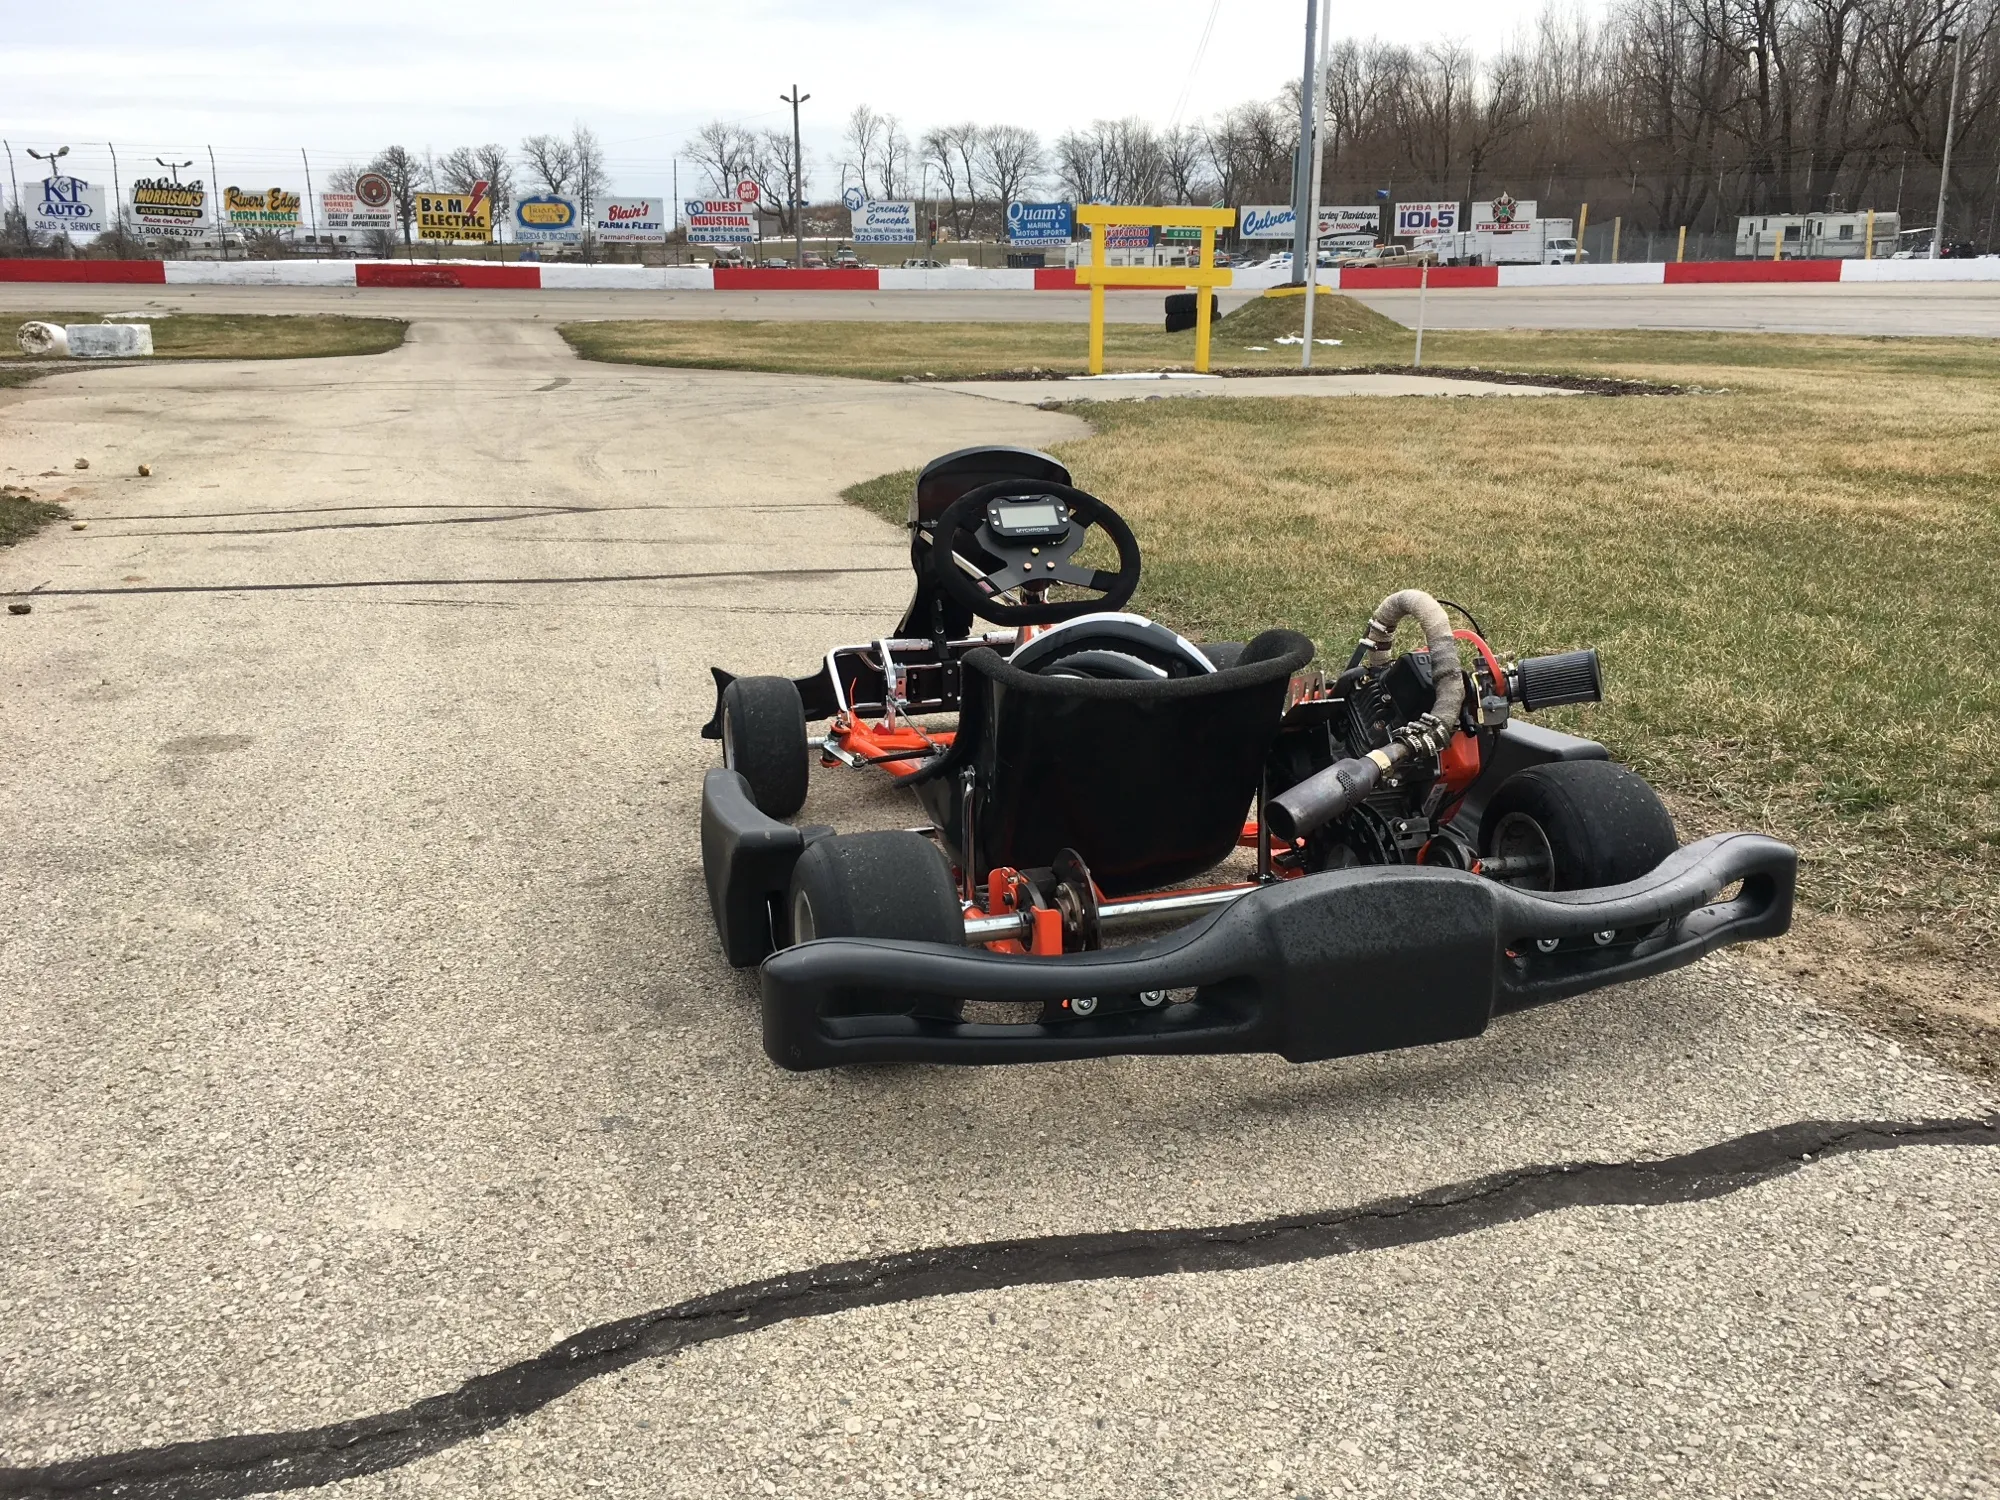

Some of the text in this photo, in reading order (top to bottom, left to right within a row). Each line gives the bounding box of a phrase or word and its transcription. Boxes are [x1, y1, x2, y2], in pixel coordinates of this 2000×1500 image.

[134, 187, 203, 206] MORRISON'S
[226, 186, 301, 213] Rivers Edge
[45, 204, 85, 216] AUTO
[420, 198, 462, 213] B & M
[608, 201, 650, 221] Blain's
[705, 201, 742, 212] QUEST
[867, 202, 910, 215] Serenity
[1007, 201, 1067, 220] Quam's
[167, 209, 199, 217] PARTS
[230, 210, 299, 221] FARM MARKET
[422, 214, 485, 227] ELECTRIC
[691, 216, 750, 226] INDUSTRIAL
[866, 214, 910, 226] Concepts
[1400, 211, 1454, 228] 101.5
[35, 221, 57, 230] SALES
[70, 222, 101, 231] SERVICE
[138, 226, 204, 237] 1.800.866.2277
[421, 230, 486, 240] 608.754.8441
